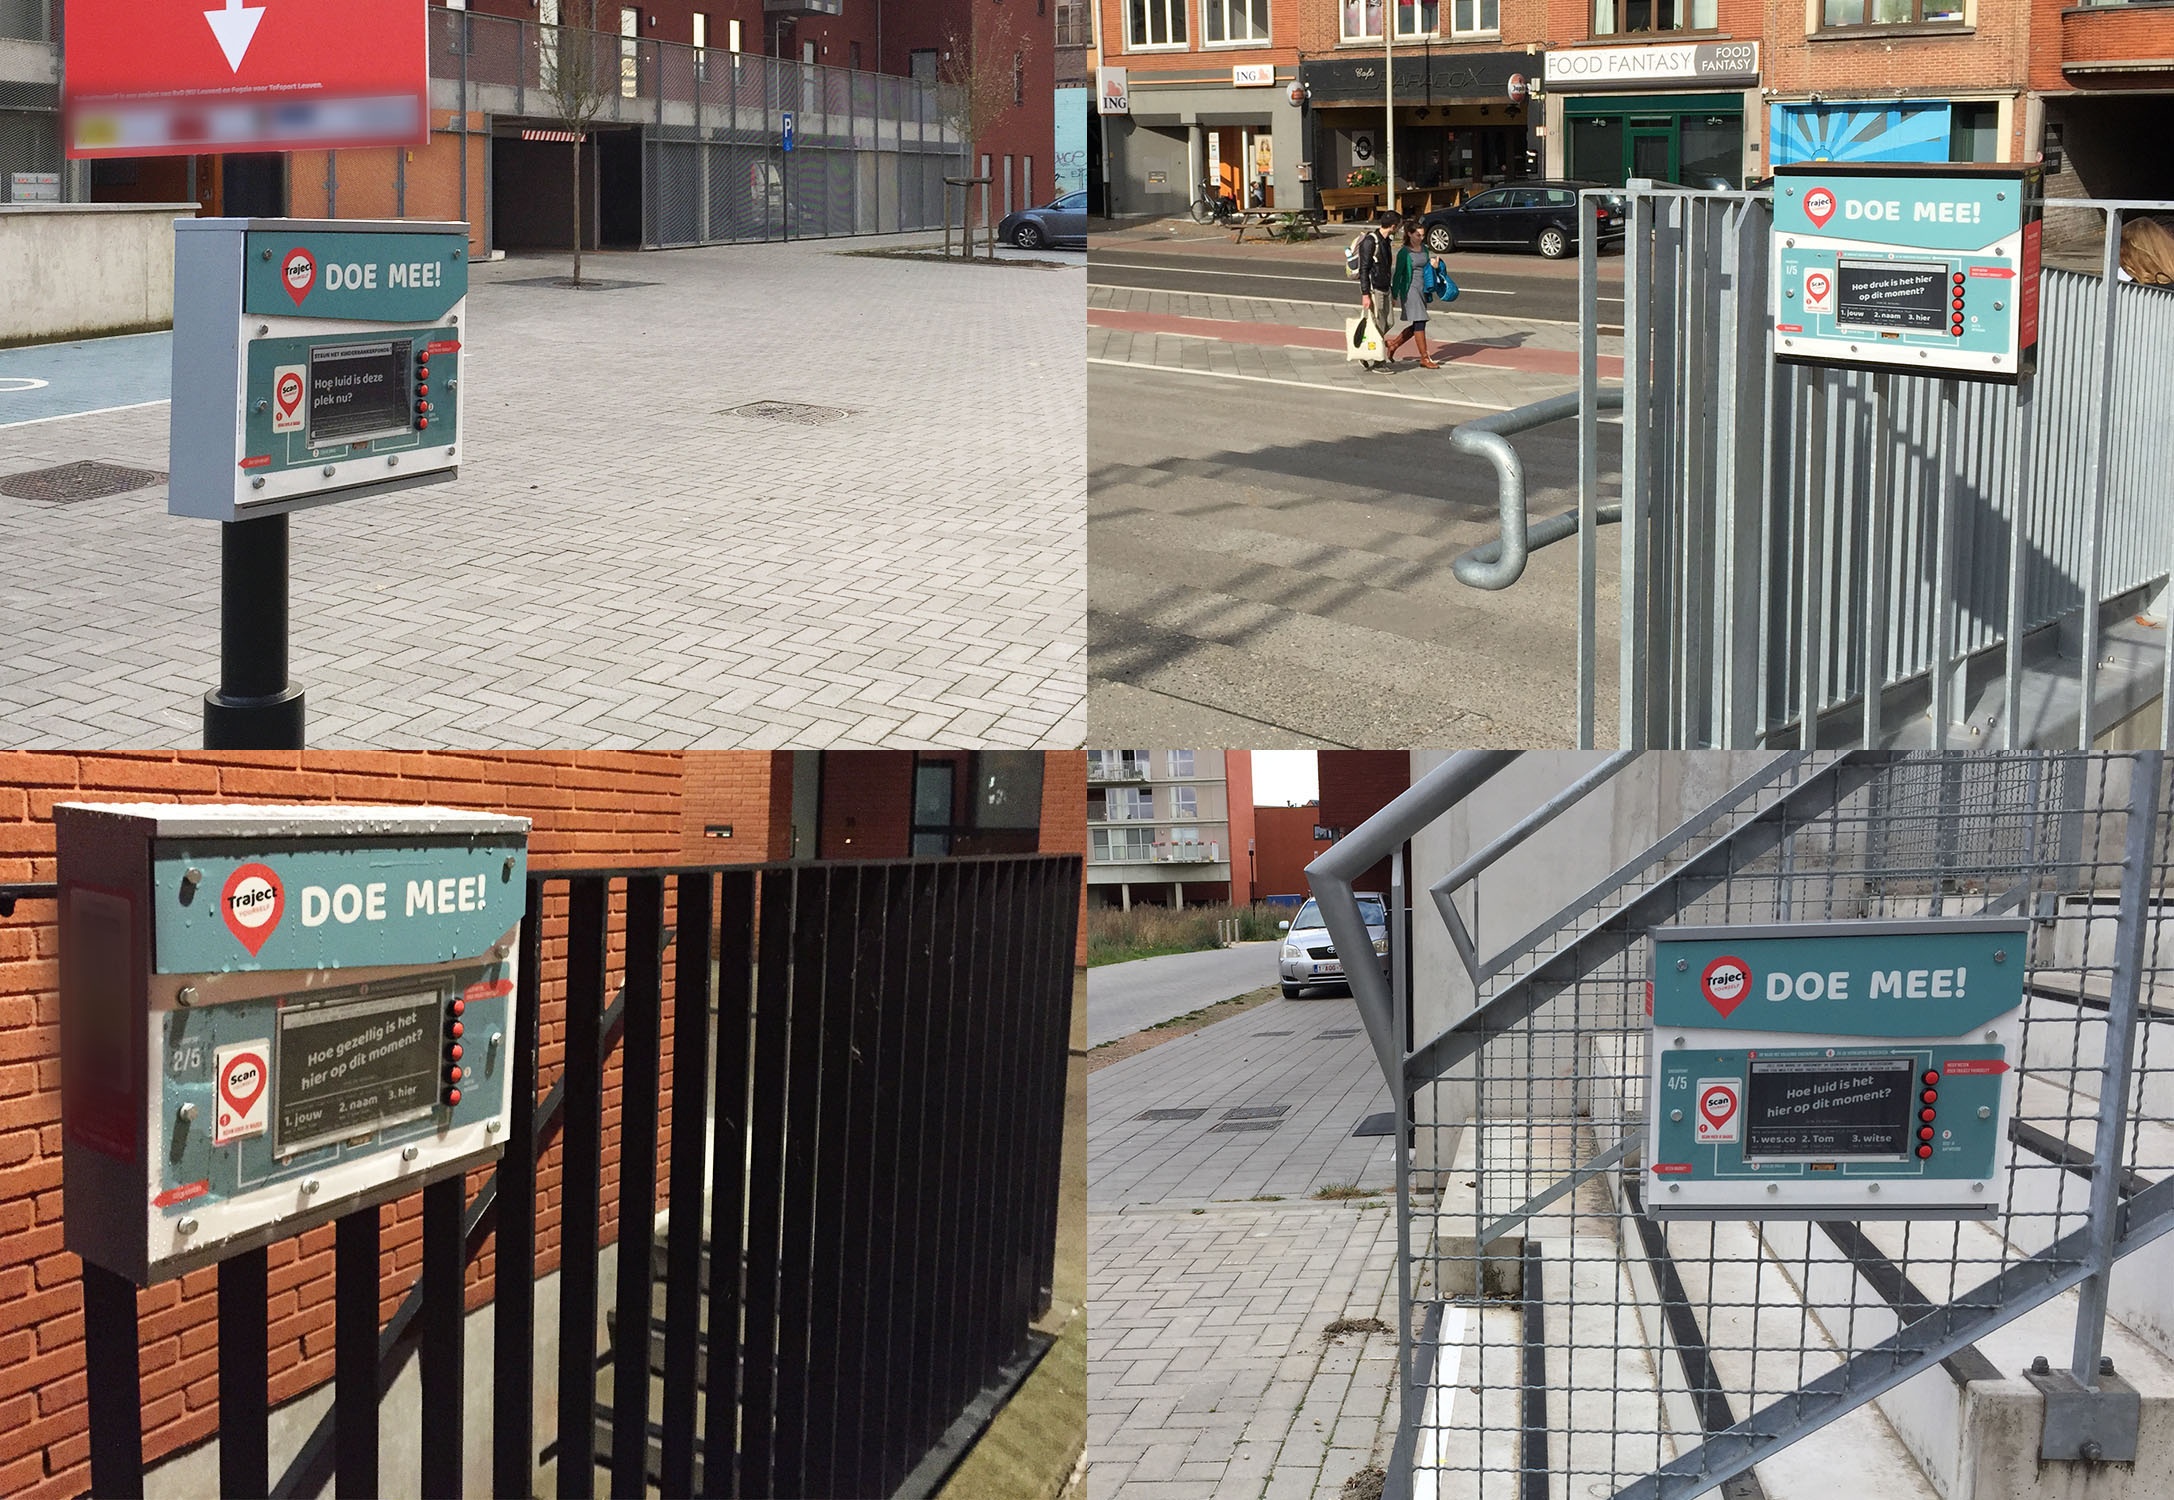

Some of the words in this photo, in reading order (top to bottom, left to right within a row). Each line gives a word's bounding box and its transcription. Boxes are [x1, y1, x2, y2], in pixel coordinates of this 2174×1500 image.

[1716, 47, 1750, 58] FOOD
[1549, 56, 1603, 75] FOOD
[1609, 52, 1692, 72] FANTASY
[1702, 59, 1751, 71] FANTASY
[1236, 71, 1256, 82] ING
[1104, 97, 1127, 109] ING
[784, 118, 792, 138] P
[1807, 198, 1832, 208] Traject
[1845, 199, 1900, 221] DOE
[1913, 202, 1981, 224] MEE!
[285, 262, 313, 276] Traject
[325, 263, 377, 290] DOE
[388, 261, 441, 288] MEE!
[1786, 265, 1798, 276] 1/5
[1852, 283, 1868, 291] Hoe
[1869, 279, 1889, 290] druk
[1890, 278, 1898, 288] is
[1899, 277, 1914, 286] het
[1915, 275, 1933, 285] hier
[1859, 292, 1870, 301] op
[1871, 290, 1883, 299] dit
[1884, 286, 1925, 298] moment?
[1847, 309, 1865, 318] jouw
[1908, 313, 1914, 321] 3.
[1915, 313, 1931, 321] hier
[314, 379, 333, 389] Hoe
[335, 376, 352, 387] luid
[353, 374, 361, 385] is
[363, 373, 383, 383] deze
[314, 394, 334, 408] plek
[336, 392, 353, 404] nu?
[228, 886, 278, 909] Traject
[301, 882, 387, 927] DOE
[405, 874, 486, 917] MEE!
[239, 903, 271, 917] YOURSELF
[1706, 970, 1746, 987] Traject
[1766, 971, 1850, 1001] DOE
[1869, 967, 1967, 999] MEE!
[1714, 983, 1740, 992] YOURSELF
[308, 1051, 334, 1067] Hoe
[336, 1028, 383, 1056] gezellig
[385, 1020, 396, 1034] is
[398, 1011, 417, 1028] het
[173, 1048, 200, 1071] 2/5
[301, 1074, 327, 1091] hier
[330, 1065, 347, 1079] op
[349, 1053, 366, 1070] dit
[368, 1029, 423, 1062] moment?
[231, 1069, 256, 1085] Scan
[1668, 1076, 1688, 1090] 4/5
[1786, 1088, 1811, 1099] Hoe
[1813, 1081, 1837, 1094] luid
[1839, 1079, 1849, 1090] is
[1852, 1076, 1874, 1088] het
[285, 1116, 292, 1127] 1.
[294, 1108, 323, 1128] jouw
[339, 1102, 348, 1113] 2.
[350, 1096, 377, 1110] naam
[388, 1089, 397, 1100] 3.
[398, 1085, 417, 1096] hier
[1708, 1098, 1729, 1106] Scan
[1767, 1106, 1792, 1118] hier
[1794, 1104, 1810, 1114] op
[1812, 1099, 1830, 1110] dit
[1832, 1088, 1892, 1107] moment?
[1761, 1135, 1796, 1144] wes.co
[1802, 1135, 1811, 1143] 2.
[1813, 1135, 1835, 1143] Tom
[1852, 1135, 1861, 1143] 3.
[1863, 1133, 1892, 1143] witse
